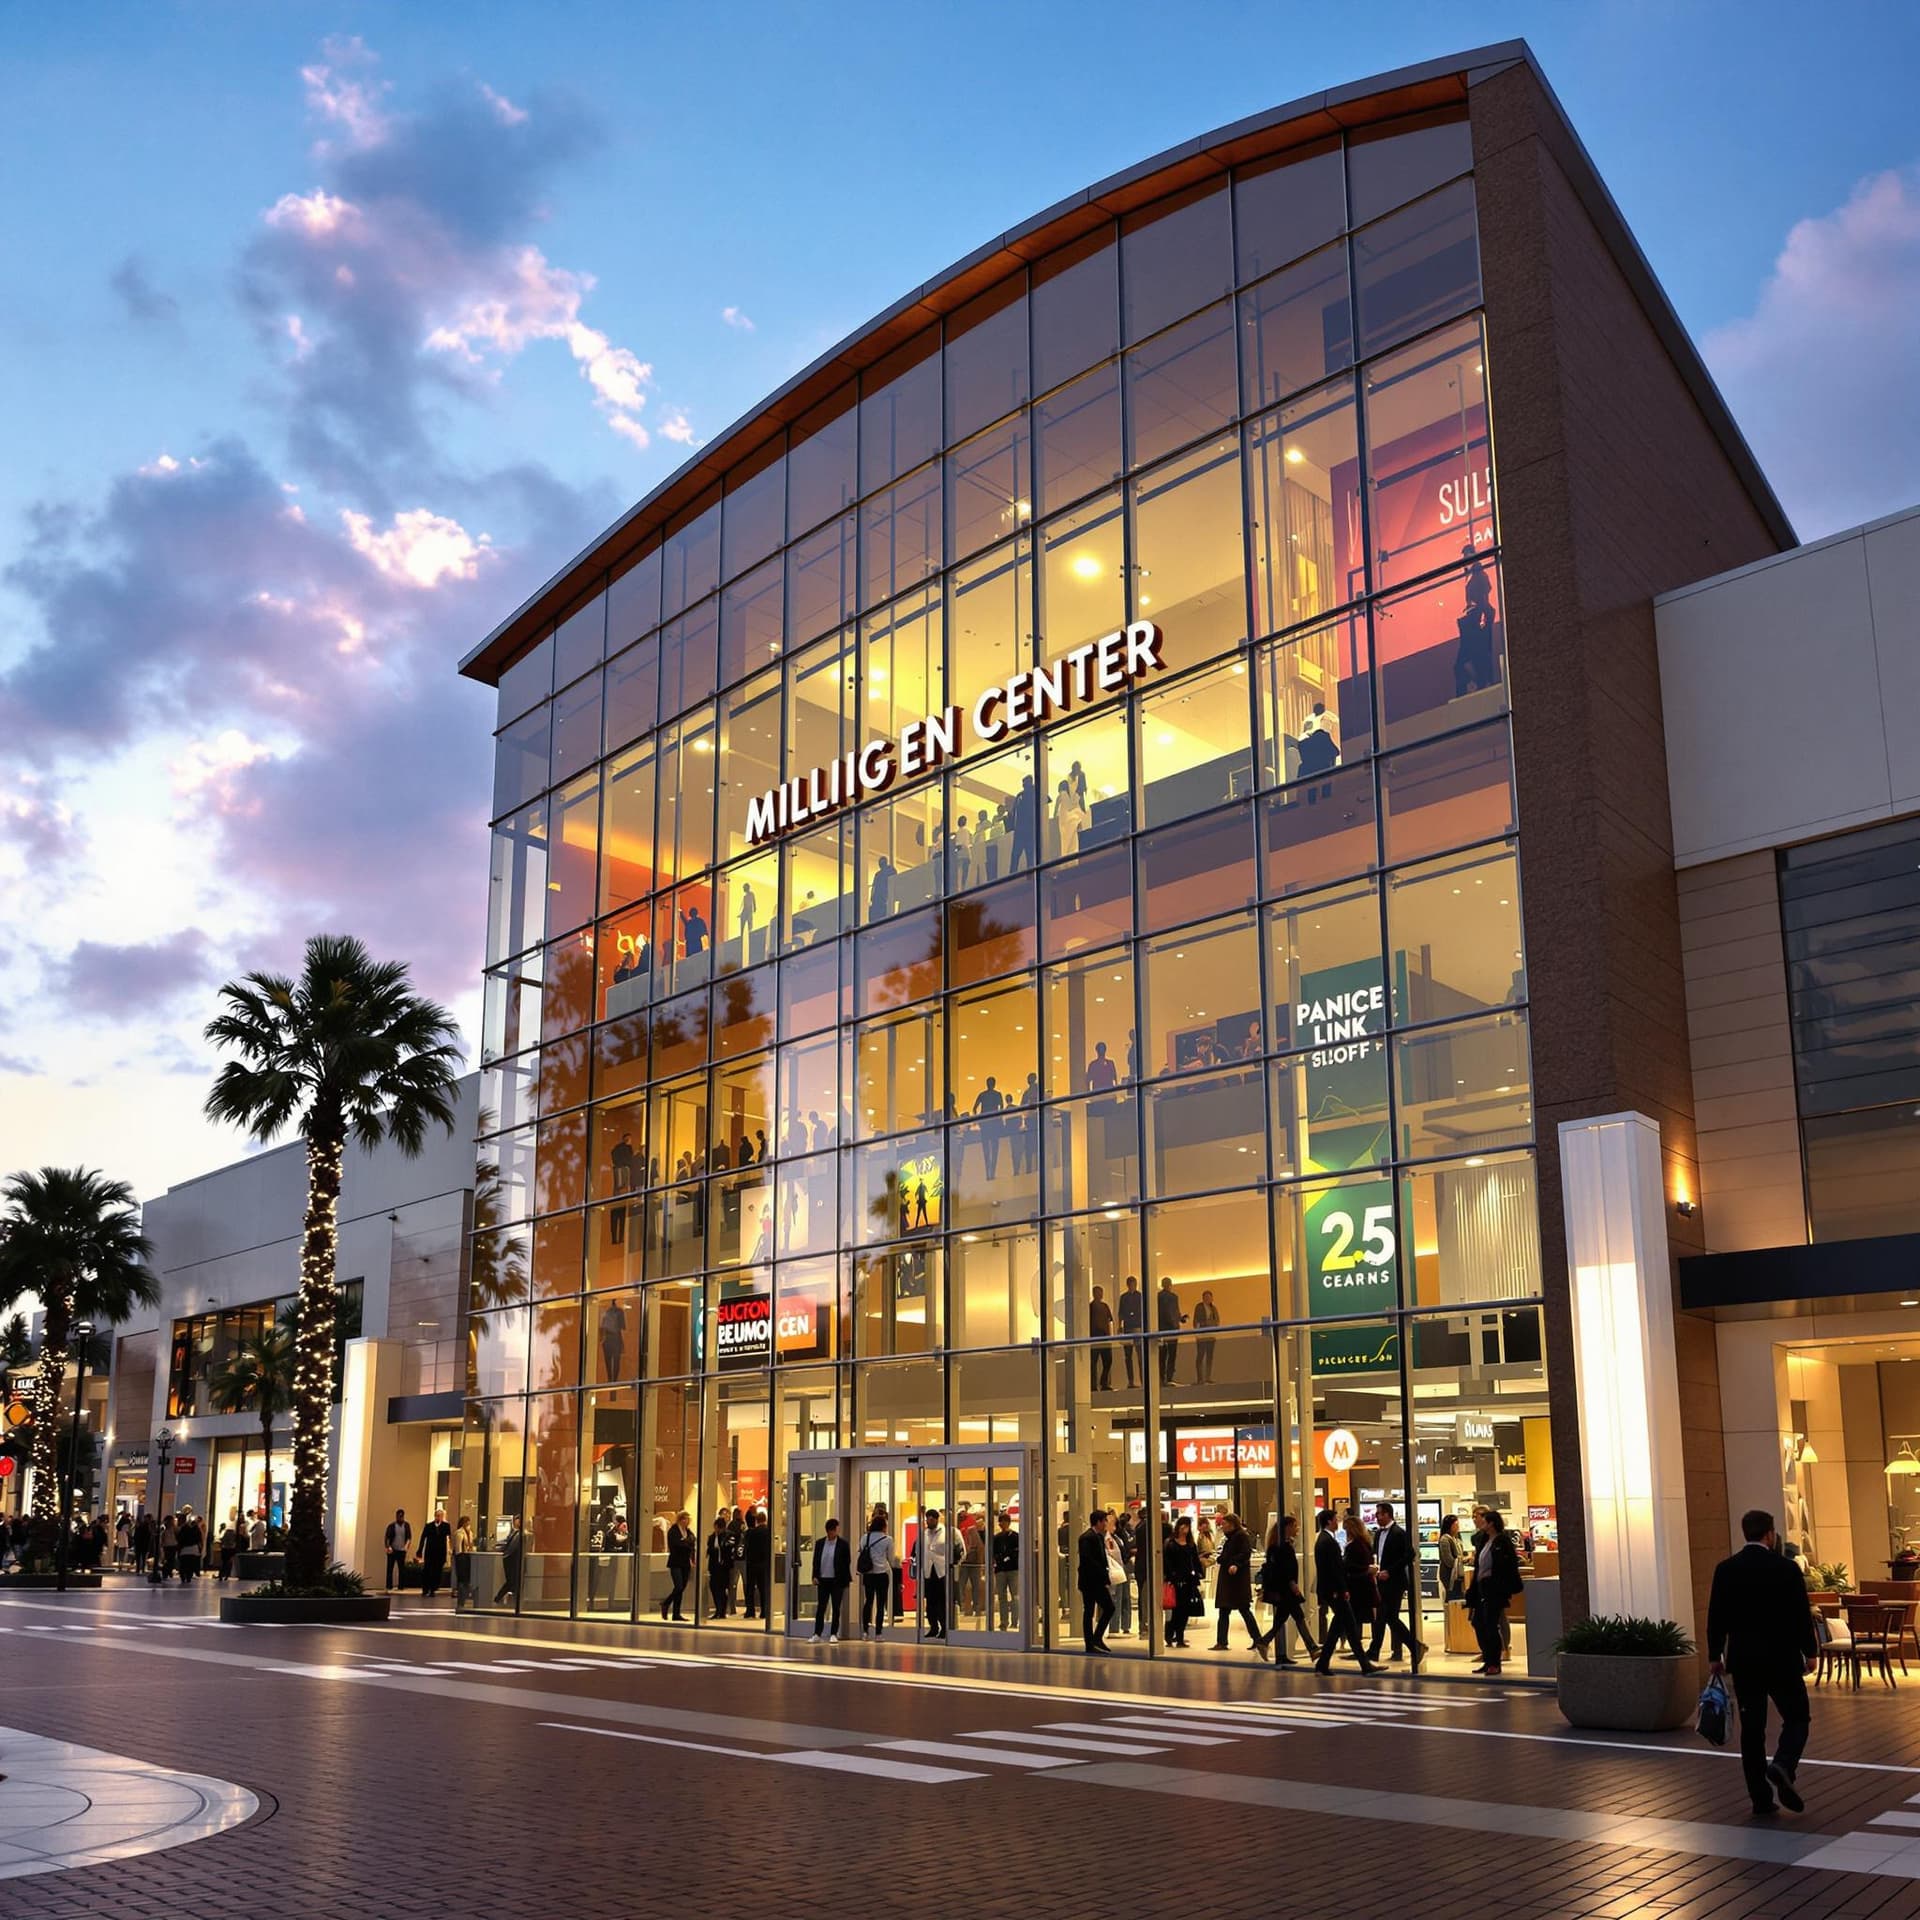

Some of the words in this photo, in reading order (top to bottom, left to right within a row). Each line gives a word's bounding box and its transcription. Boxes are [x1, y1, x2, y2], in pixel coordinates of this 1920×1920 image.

[972, 619, 1167, 742] CENTER
[1296, 985, 1384, 1026] PANICE
[1314, 1014, 1368, 1045] LINK
[1323, 1270, 1390, 1289] CEARNS
[1202, 1445, 1270, 1463] LITERAN
[1332, 1443, 1349, 1460] M
